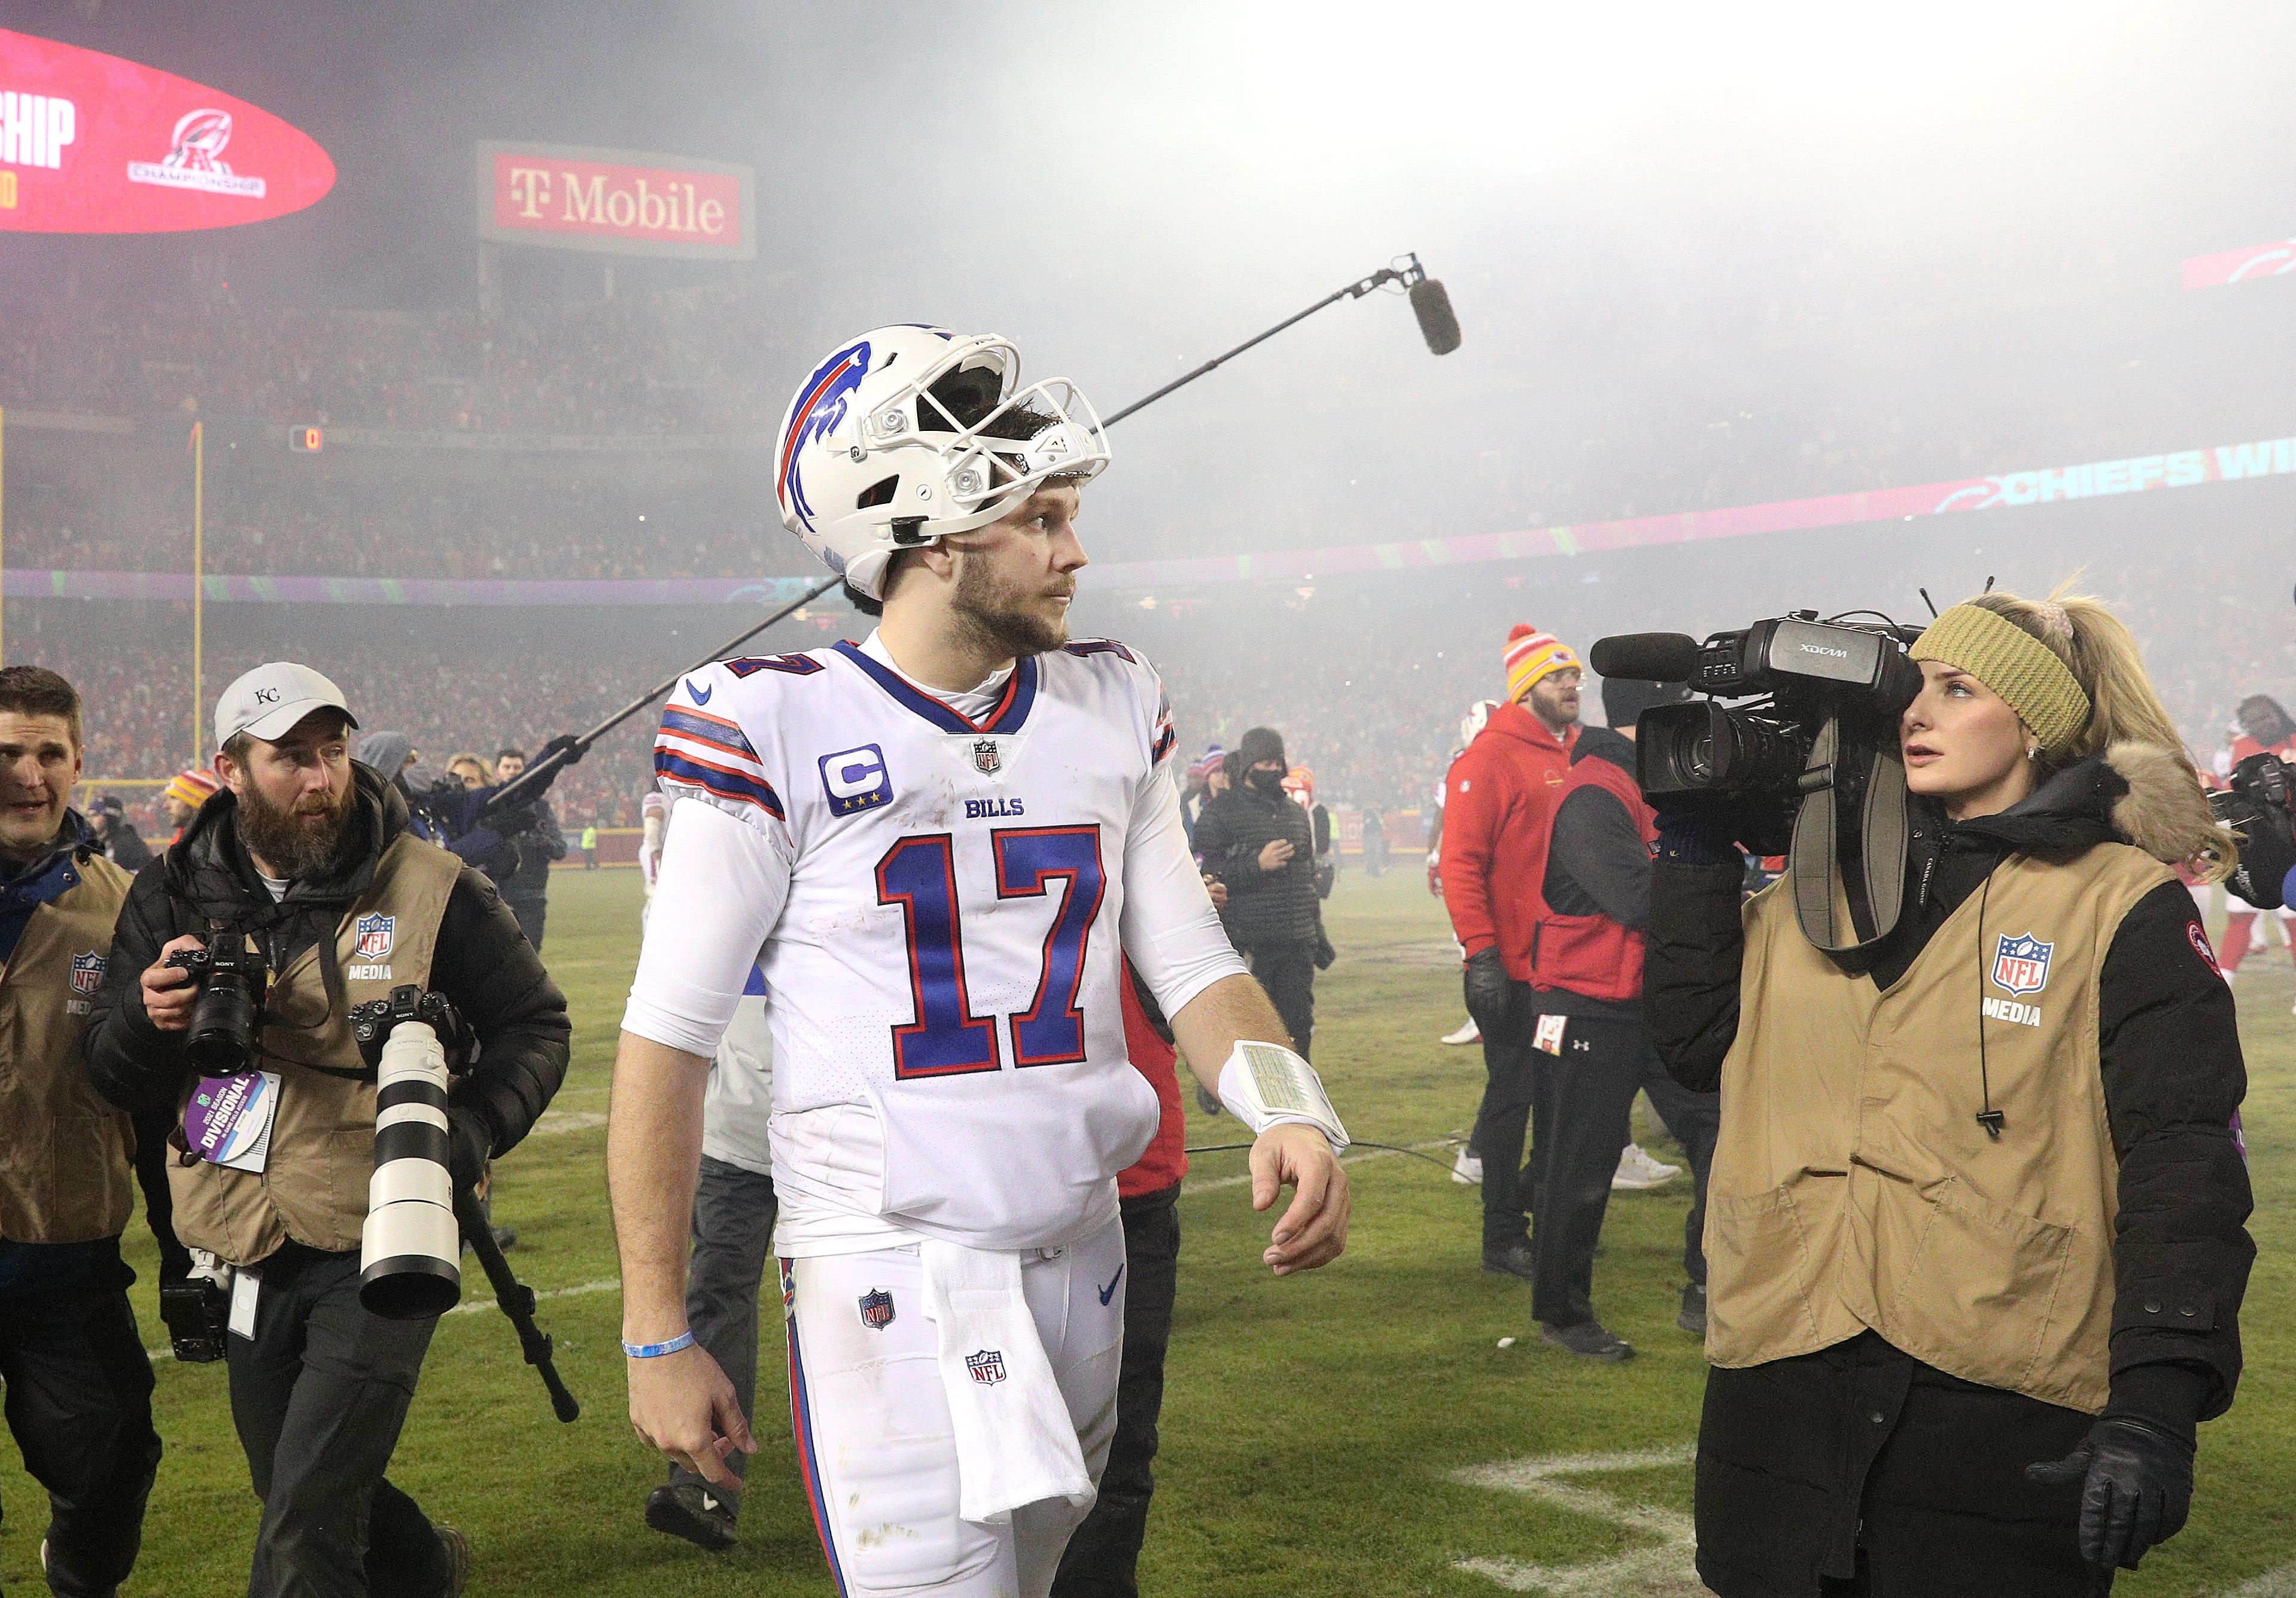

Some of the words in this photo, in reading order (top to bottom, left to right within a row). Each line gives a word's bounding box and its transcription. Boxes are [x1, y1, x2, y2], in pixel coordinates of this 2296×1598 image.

[0, 90, 75, 169] HIP
[561, 172, 725, 234] Mobile
[305, 428, 321, 450] 0
[2002, 450, 2206, 506] CHIEFS
[2216, 437, 2296, 480] WI
[1799, 643, 1847, 658] XDCAM
[254, 687, 280, 705] KC
[978, 754, 998, 769] NFL
[825, 749, 884, 798] C
[964, 798, 1024, 819] BILLS
[1922, 857, 1933, 882] CANADA
[358, 932, 388, 954] NFL
[874, 823, 1107, 1081] 17
[348, 964, 392, 980] MEDIA
[1997, 957, 2039, 988] NFL
[1982, 997, 2041, 1027] MEDIA
[211, 1087, 227, 1110] SEASON
[200, 1077, 250, 1149] DIVISIONAL
[865, 1305, 890, 1323] NFL
[971, 1365, 1003, 1382] NFL
